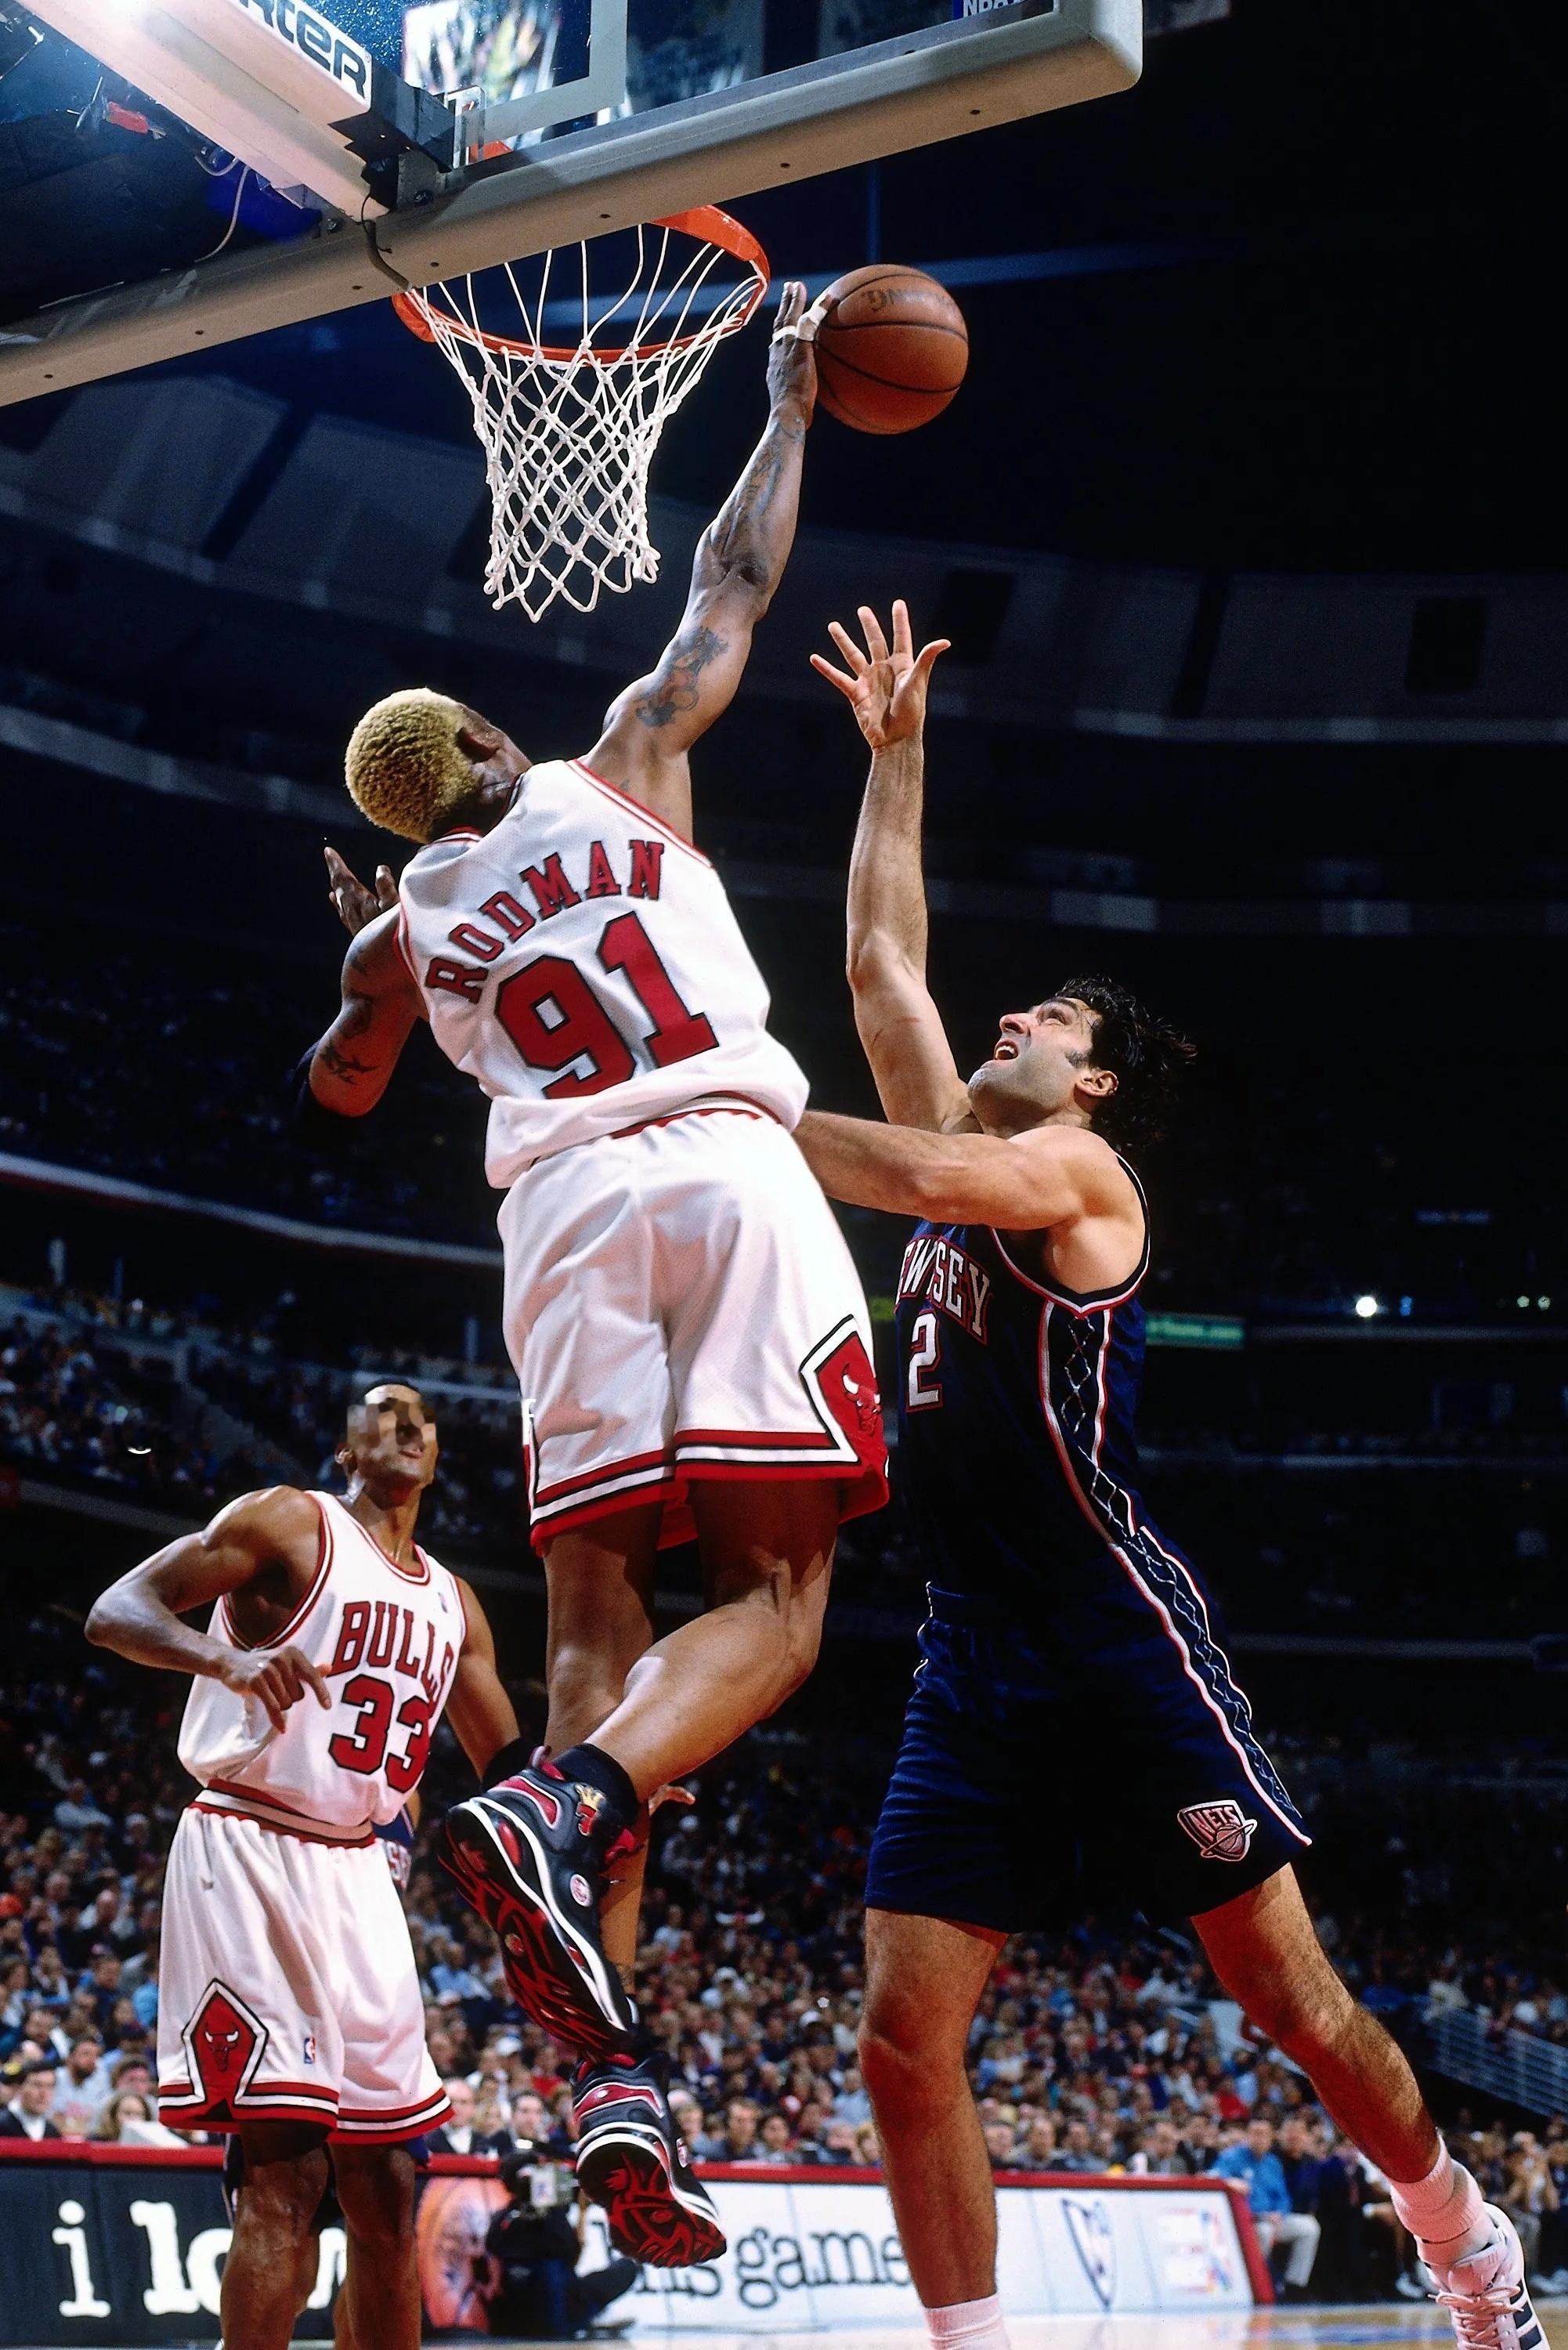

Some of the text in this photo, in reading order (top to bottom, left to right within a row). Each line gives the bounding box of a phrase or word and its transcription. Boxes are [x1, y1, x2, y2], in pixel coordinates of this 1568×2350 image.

[425, 839, 665, 1004] RODMAN
[494, 911, 720, 1100] 91
[326, 1600, 455, 1719] BULLS
[328, 1673, 432, 1794] 33
[1187, 1806, 1241, 1842] NETS
[52, 2200, 111, 2319] i
[736, 2227, 911, 2309] game
